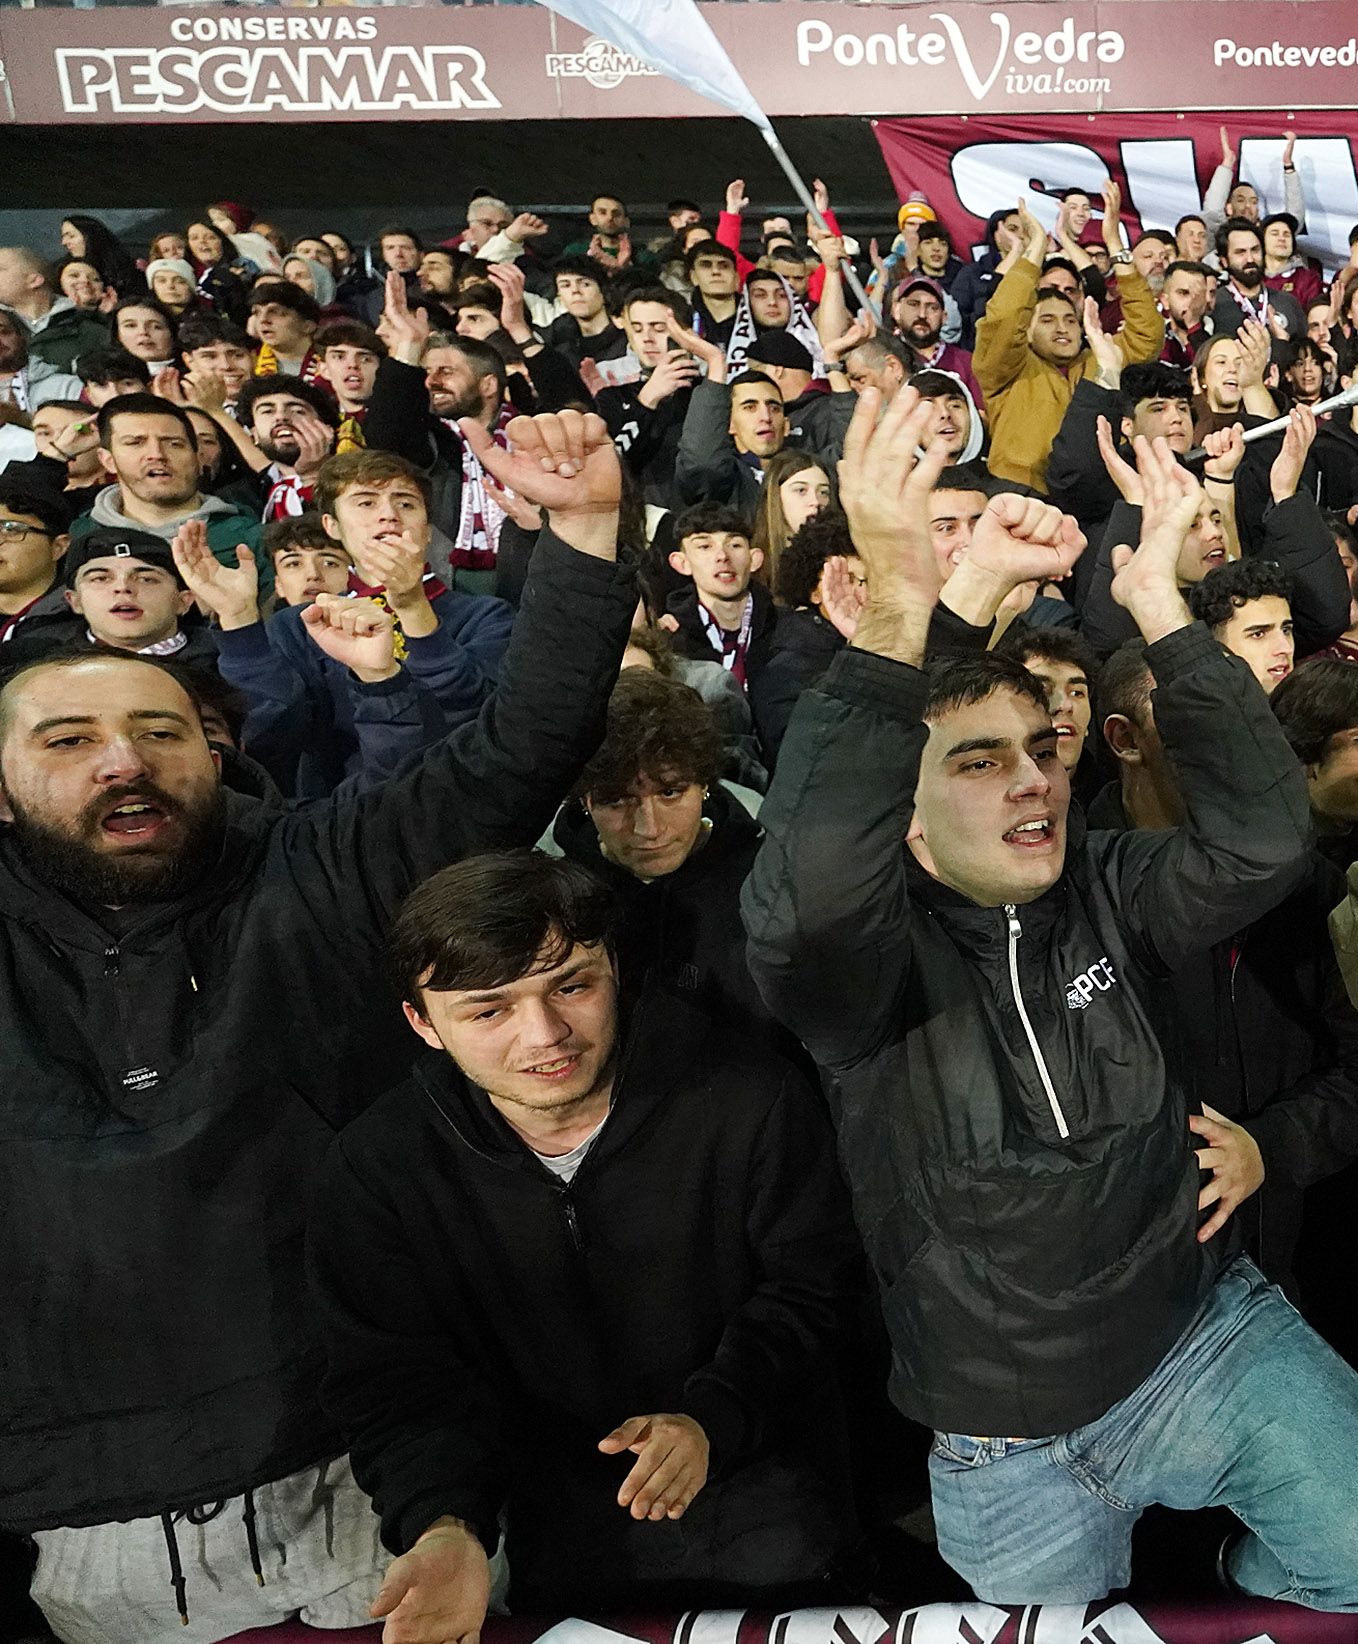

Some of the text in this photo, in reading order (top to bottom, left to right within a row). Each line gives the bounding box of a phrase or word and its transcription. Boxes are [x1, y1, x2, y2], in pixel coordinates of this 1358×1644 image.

[170, 16, 378, 42] CONSERVAS
[546, 54, 663, 77] PESCAMA
[55, 46, 502, 113] PESCAMAR
